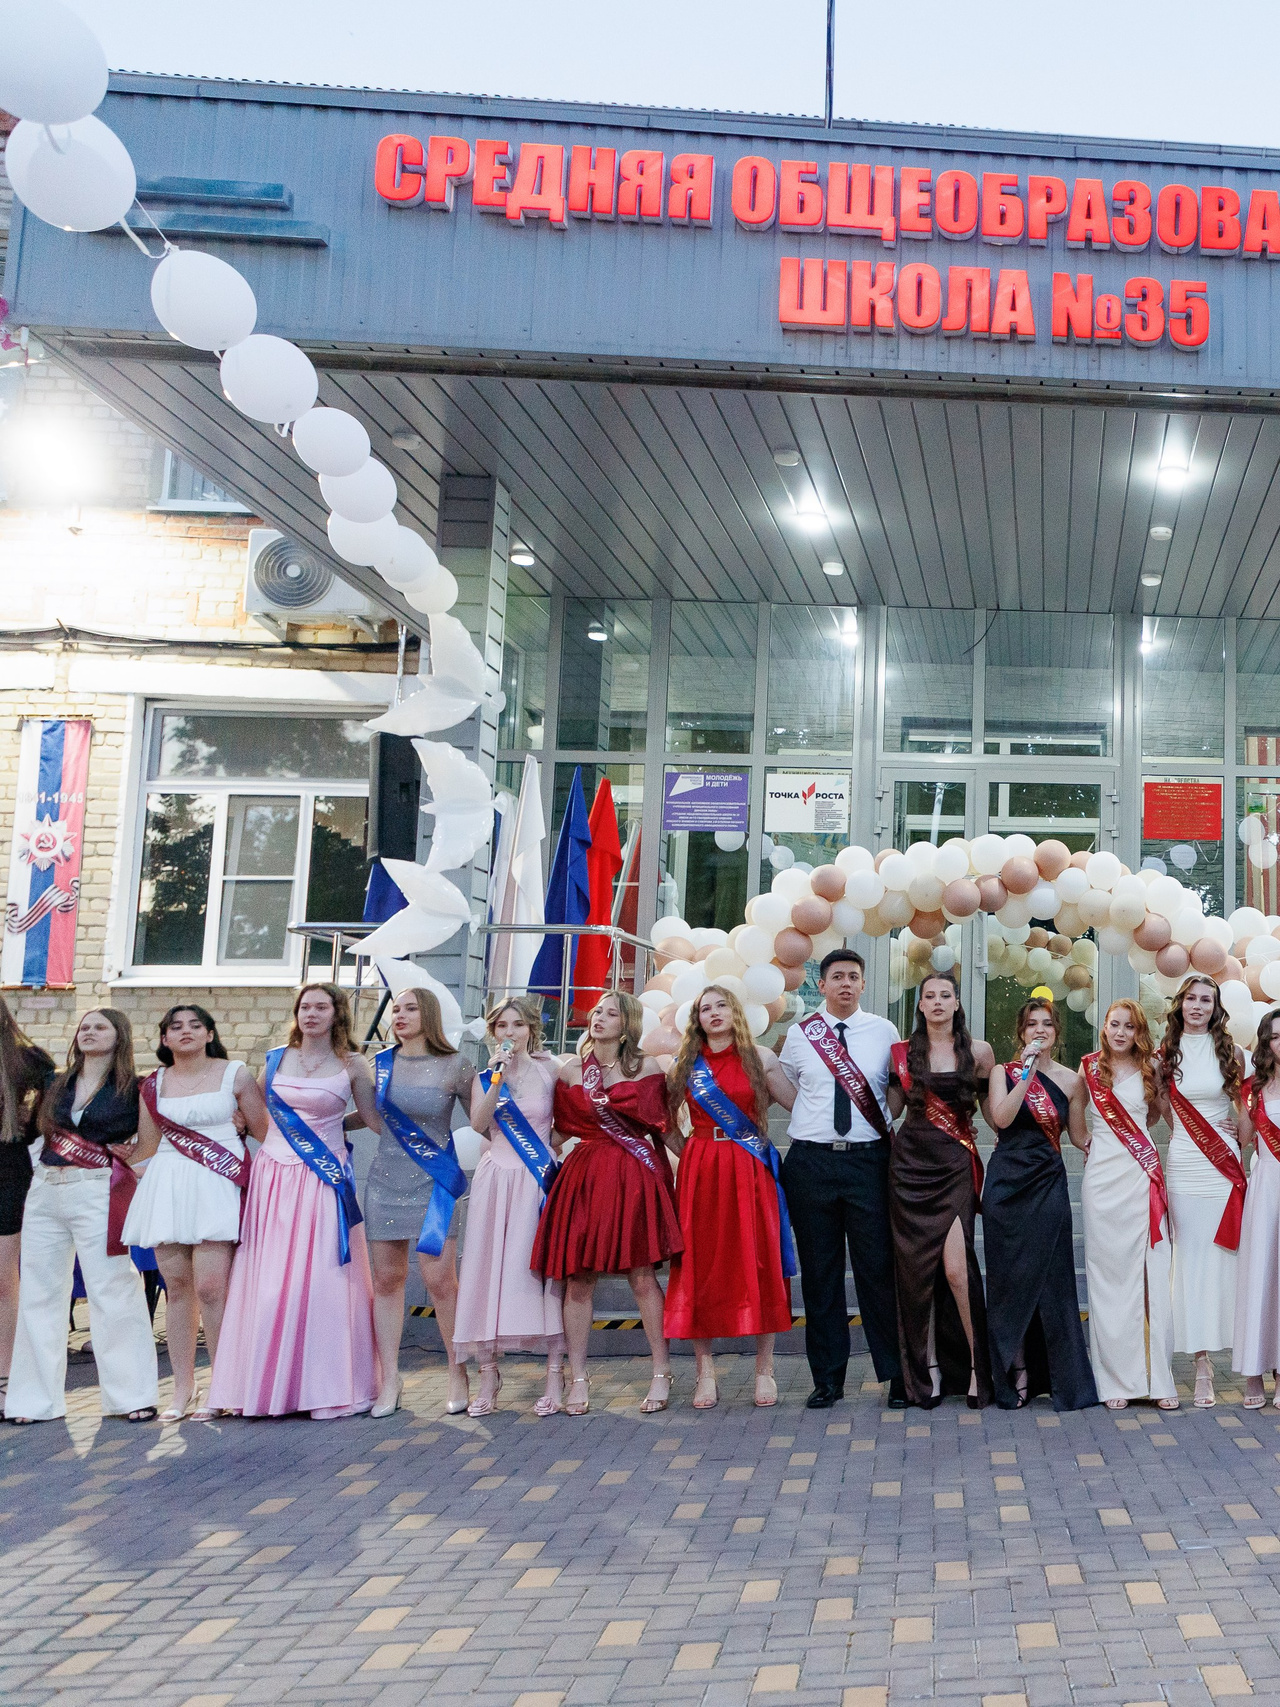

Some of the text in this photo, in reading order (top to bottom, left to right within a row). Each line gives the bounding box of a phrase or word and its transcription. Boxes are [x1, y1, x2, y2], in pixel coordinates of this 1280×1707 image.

[374, 133, 715, 229] СРЕДНЯЯ
[779, 256, 1211, 352] ШКОЛА №35
[769, 791, 845, 800] ТОЧКА РОСТА
